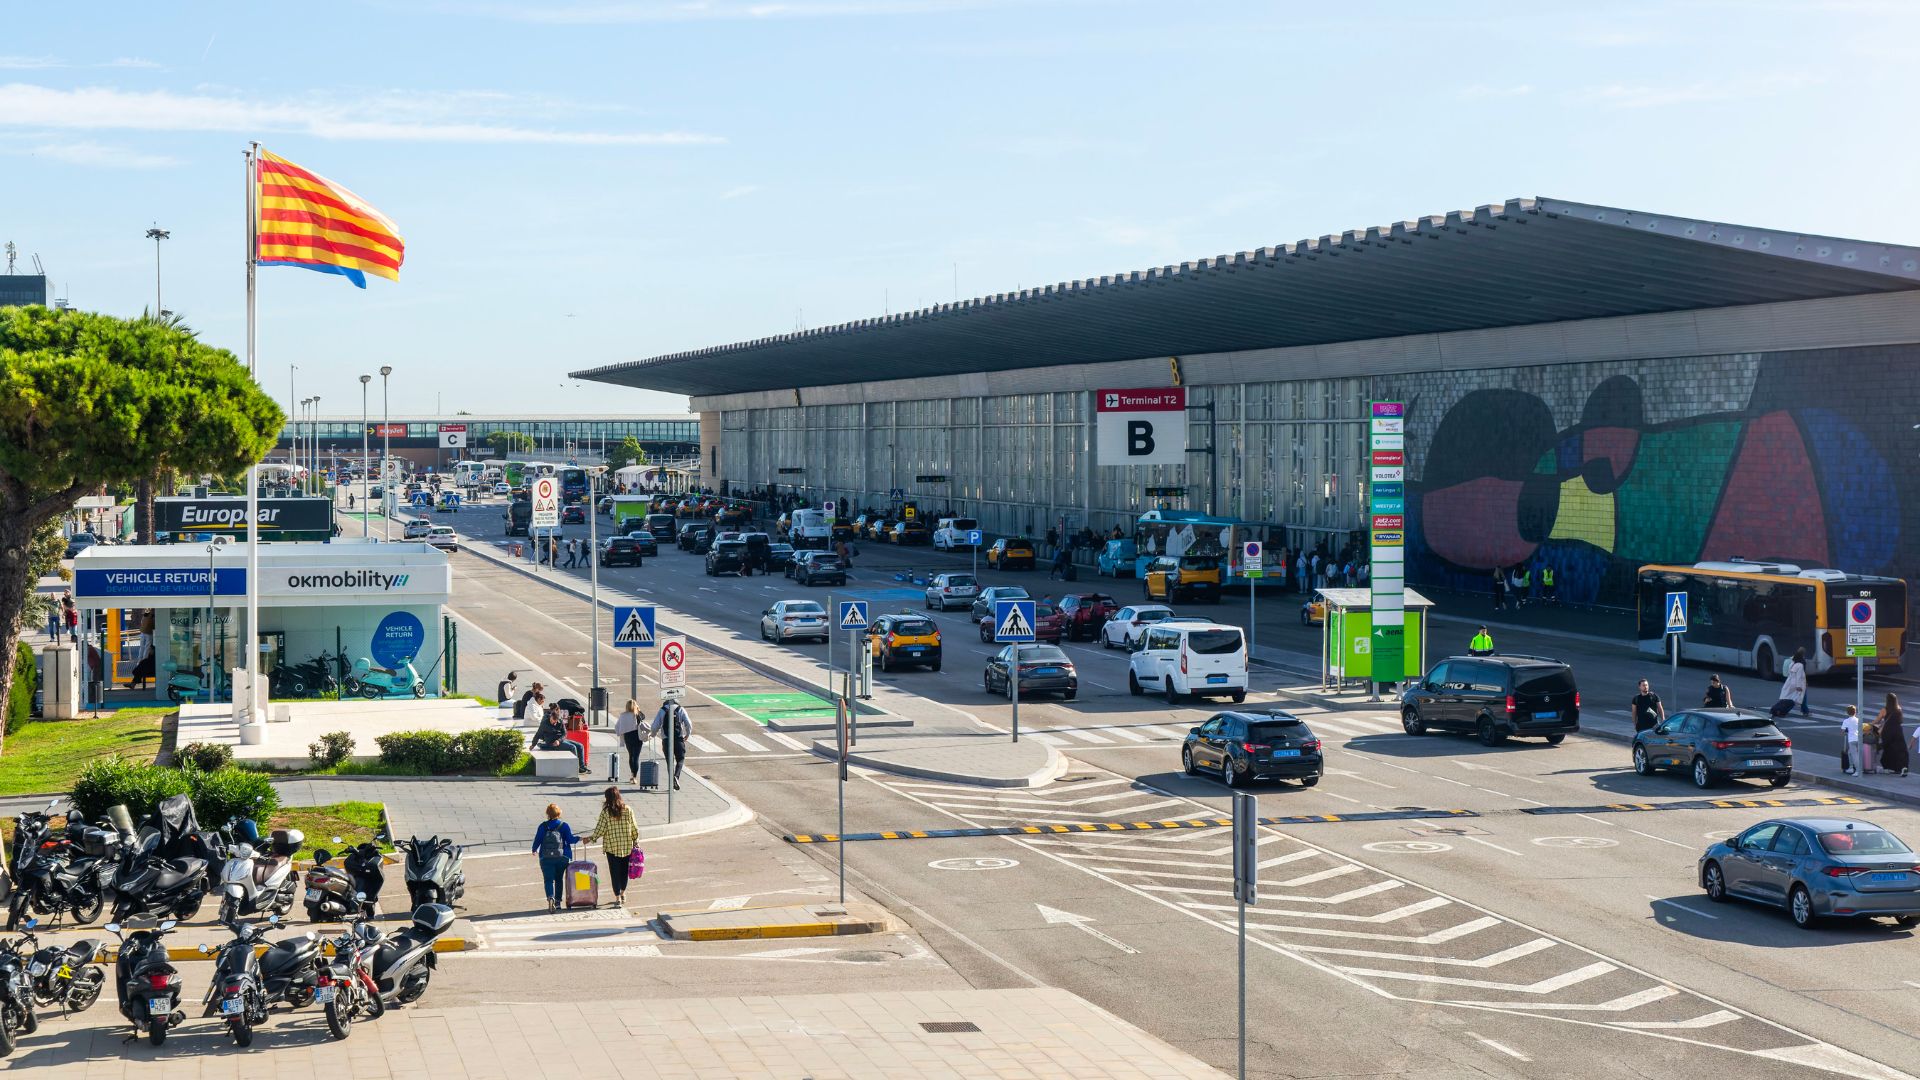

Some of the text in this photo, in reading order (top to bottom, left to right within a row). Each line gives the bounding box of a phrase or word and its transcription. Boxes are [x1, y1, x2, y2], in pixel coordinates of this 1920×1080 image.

[1120, 395, 1177, 405] Terminal T2
[447, 434, 458, 445] C
[1127, 420, 1156, 456] B
[970, 531, 979, 544] P
[105, 572, 218, 584] VEHICLE RETURN
[287, 570, 393, 590] okmobility
[105, 584, 159, 593] DEVOLUCIÓN
